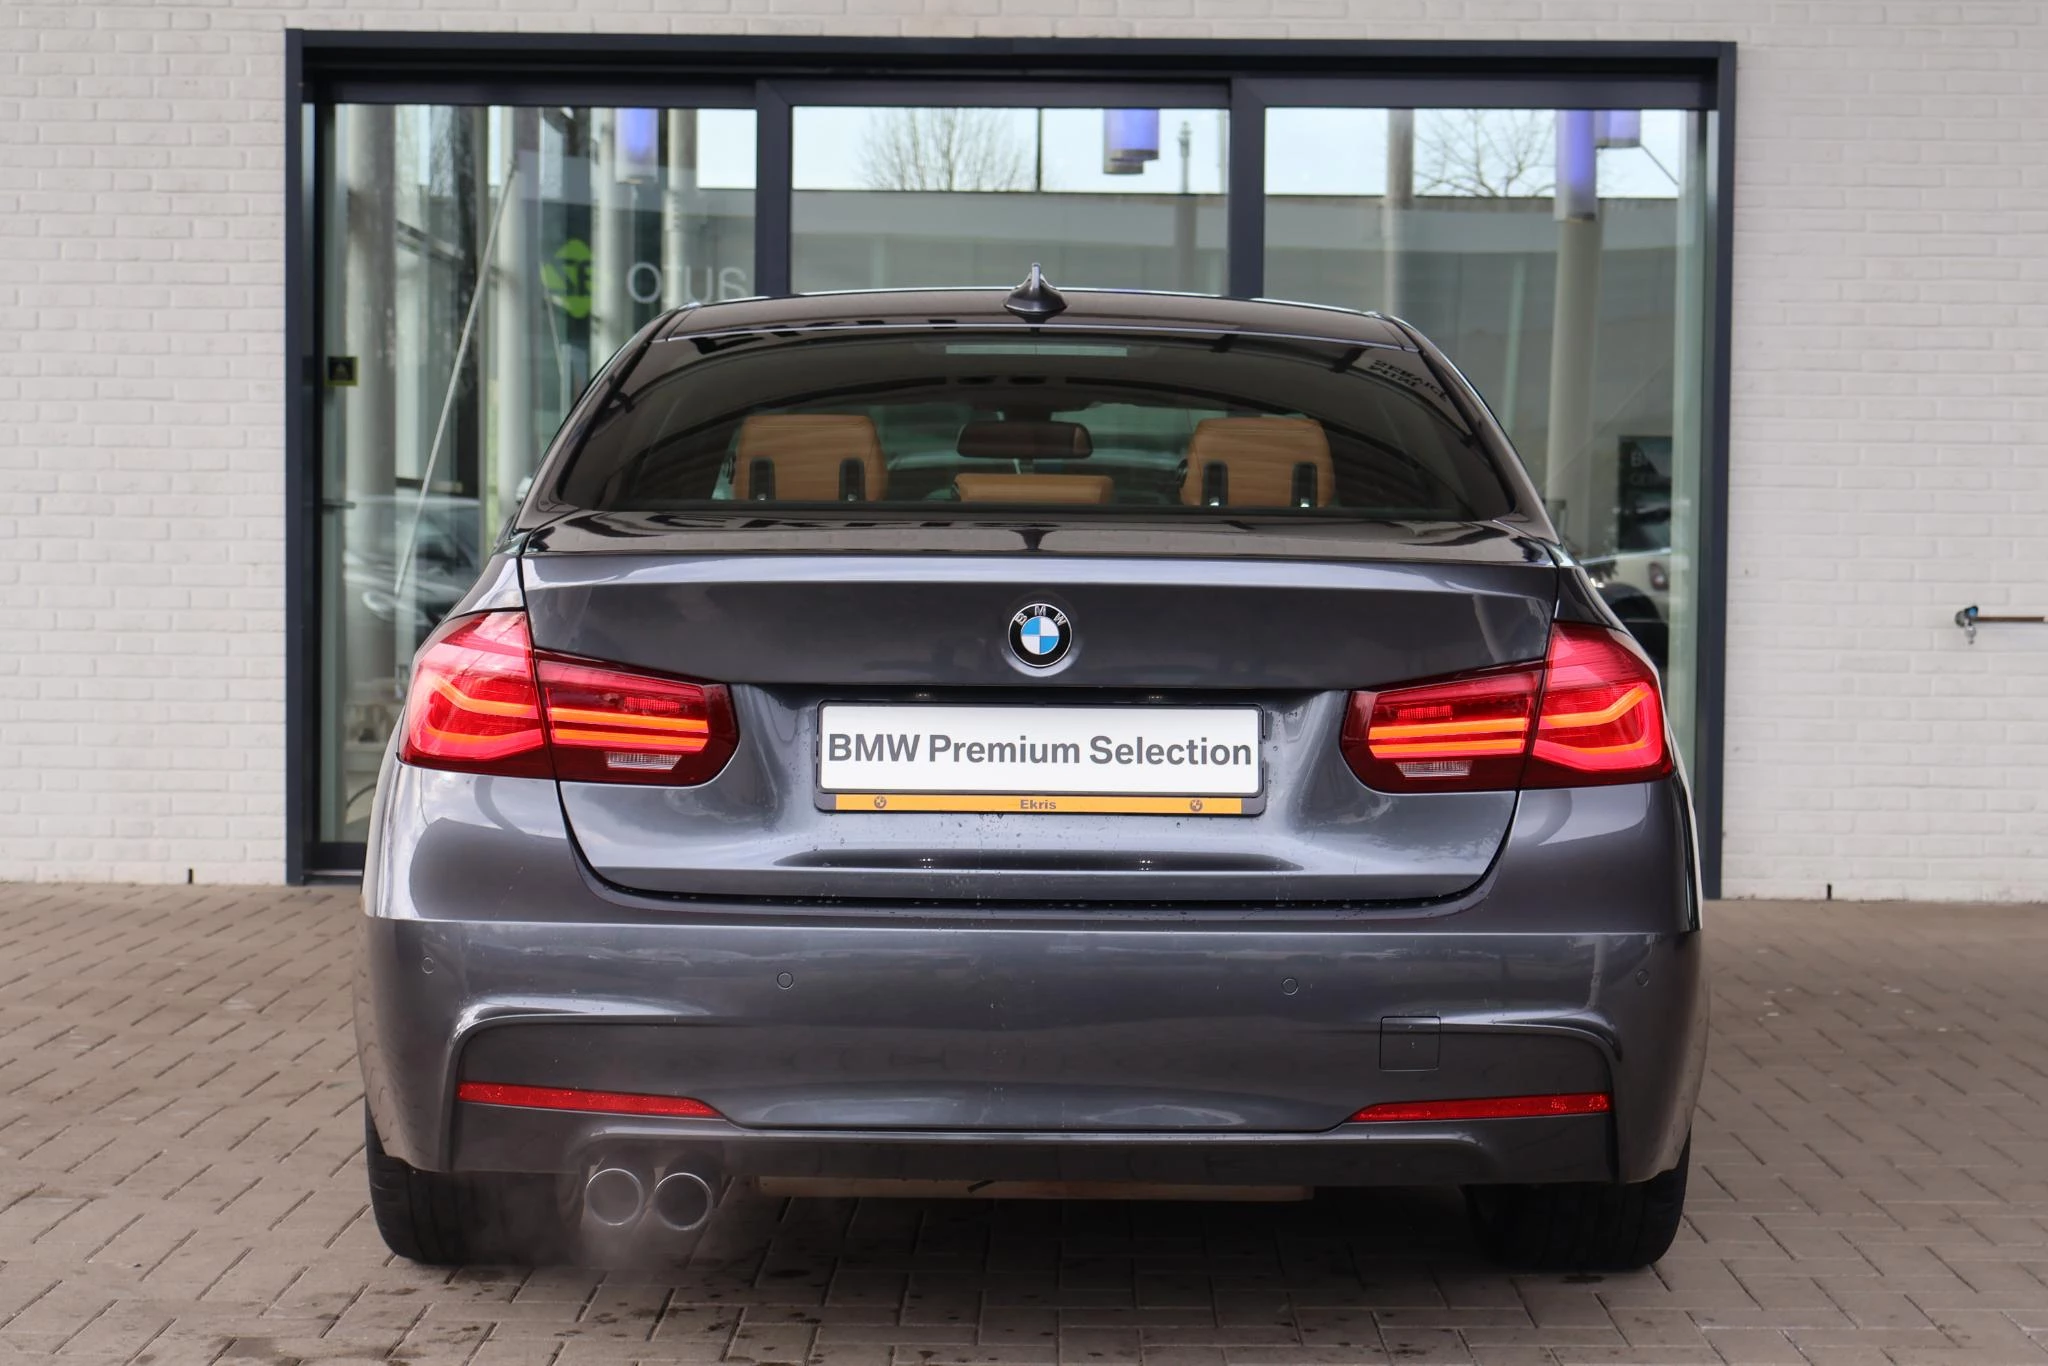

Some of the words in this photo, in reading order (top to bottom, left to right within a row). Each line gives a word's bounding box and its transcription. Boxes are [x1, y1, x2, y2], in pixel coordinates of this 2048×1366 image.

[1014, 605, 1067, 626] BMW
[828, 733, 921, 762] BMW
[929, 734, 1080, 764] Premium
[1089, 735, 1252, 766] Selection
[1020, 799, 1057, 810] Ekris
